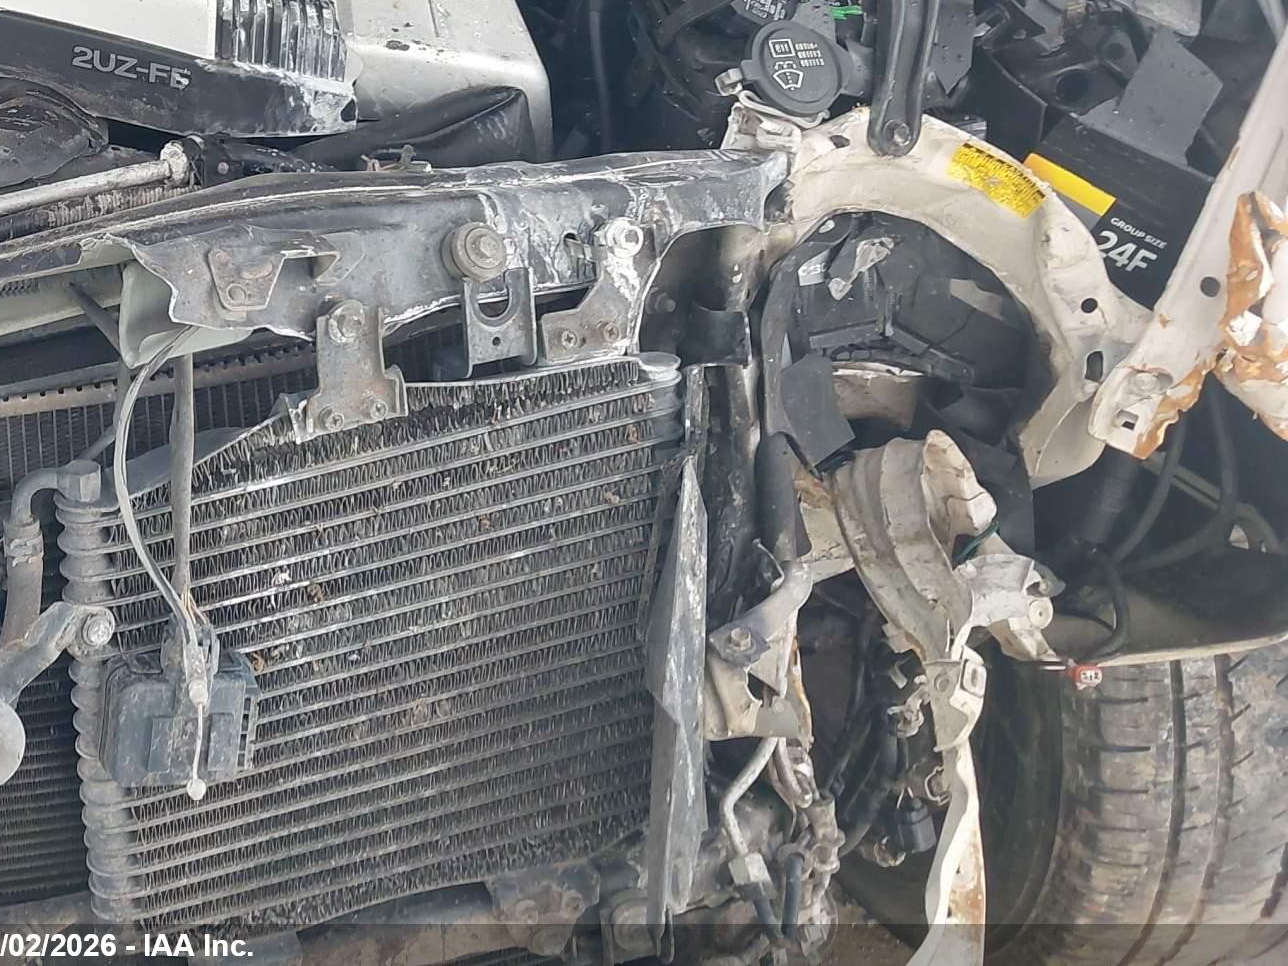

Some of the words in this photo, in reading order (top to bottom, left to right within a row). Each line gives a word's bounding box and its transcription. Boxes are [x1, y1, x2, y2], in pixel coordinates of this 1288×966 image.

[1096, 230, 1158, 272] 24F
[1110, 217, 1146, 239] GROUP
[1144, 235, 1169, 250] SIZE
